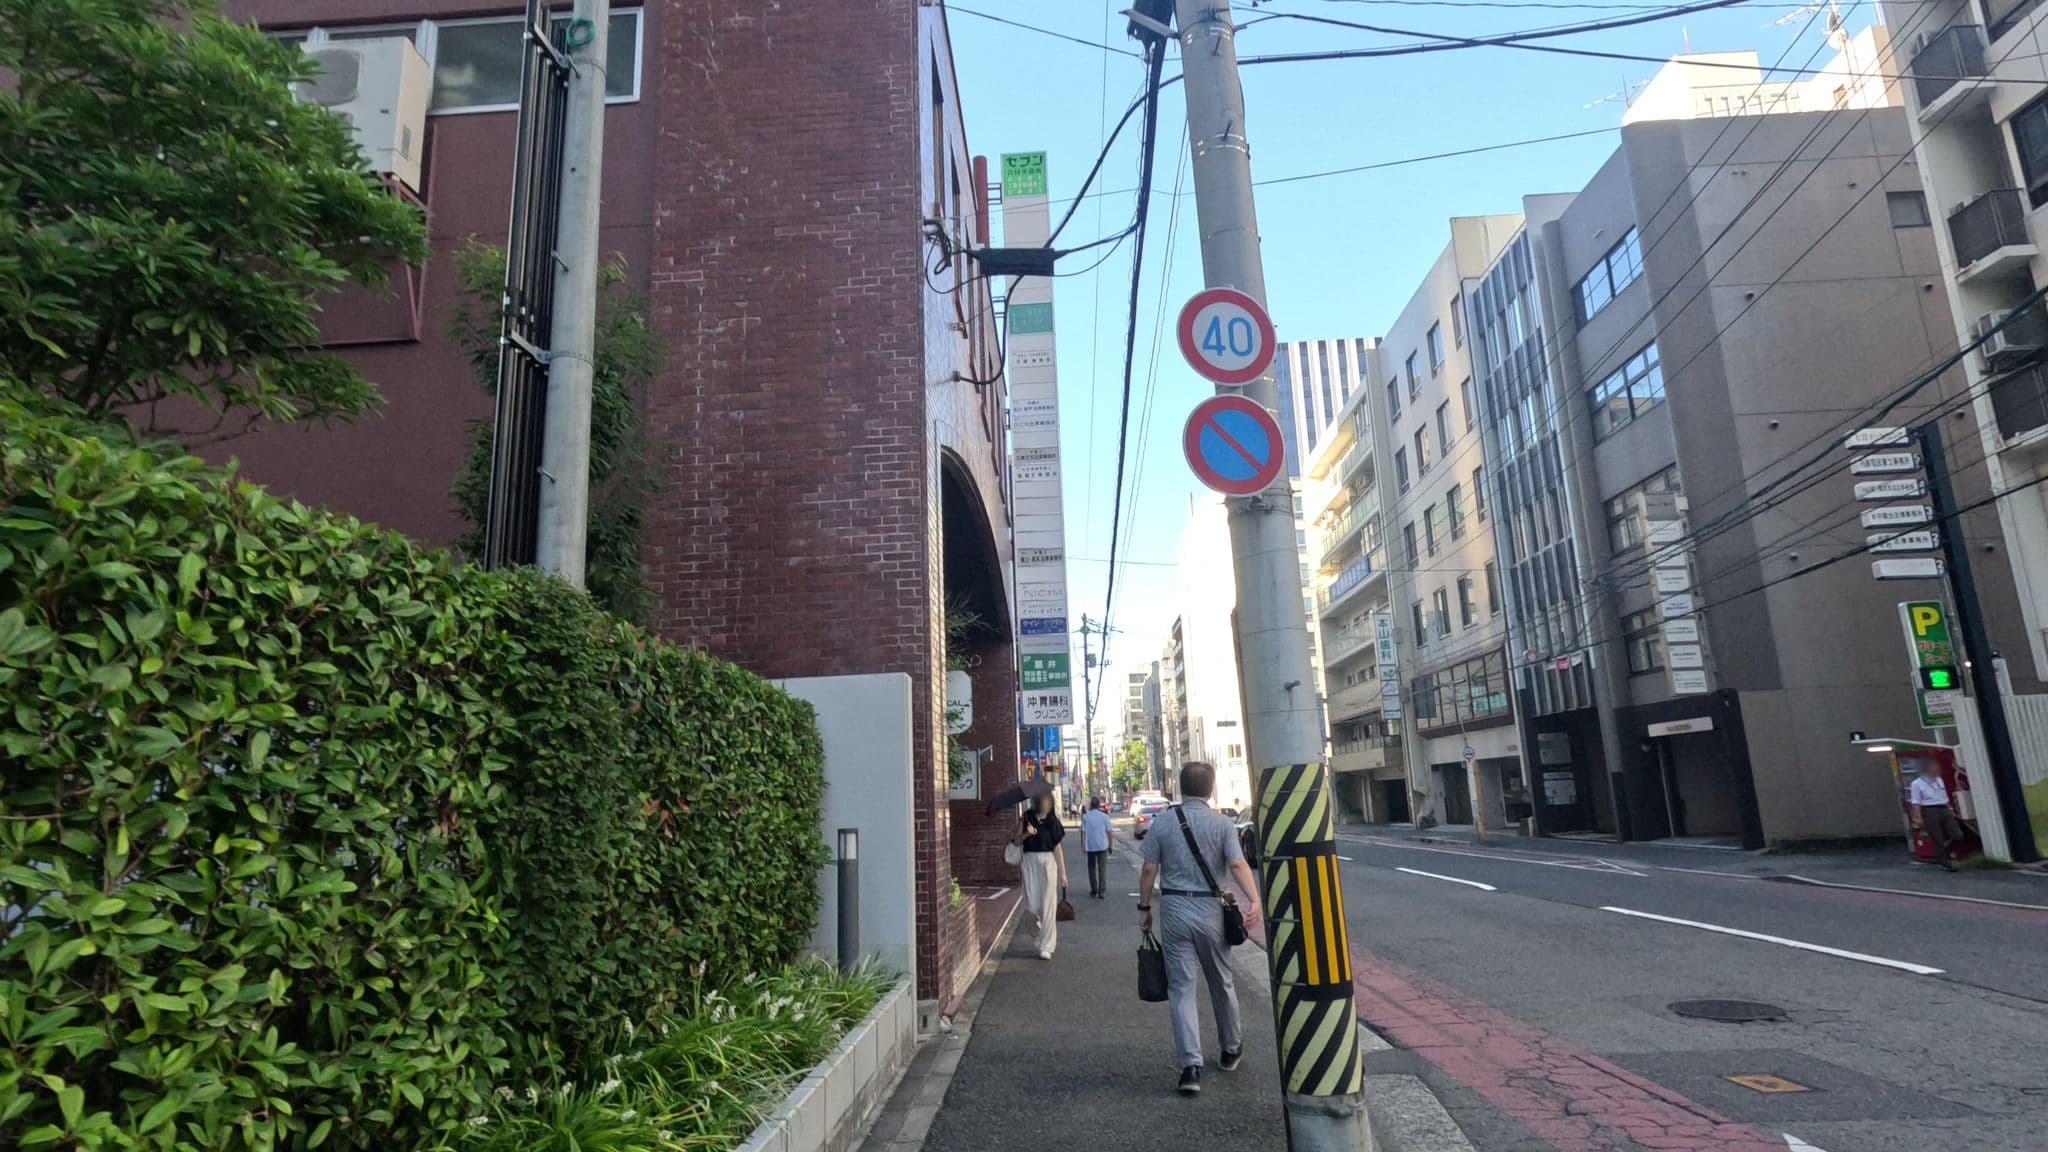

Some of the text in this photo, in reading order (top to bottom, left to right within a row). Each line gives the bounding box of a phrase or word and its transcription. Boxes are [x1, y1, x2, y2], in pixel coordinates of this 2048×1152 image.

[1006, 155, 1043, 168] セブン
[1202, 315, 1254, 357] 40
[1912, 606, 1940, 637] P
[1378, 618, 1392, 660] 本山歯科
[1027, 695, 1069, 708] 沖胃腸科
[1034, 709, 1069, 720] クリニック
